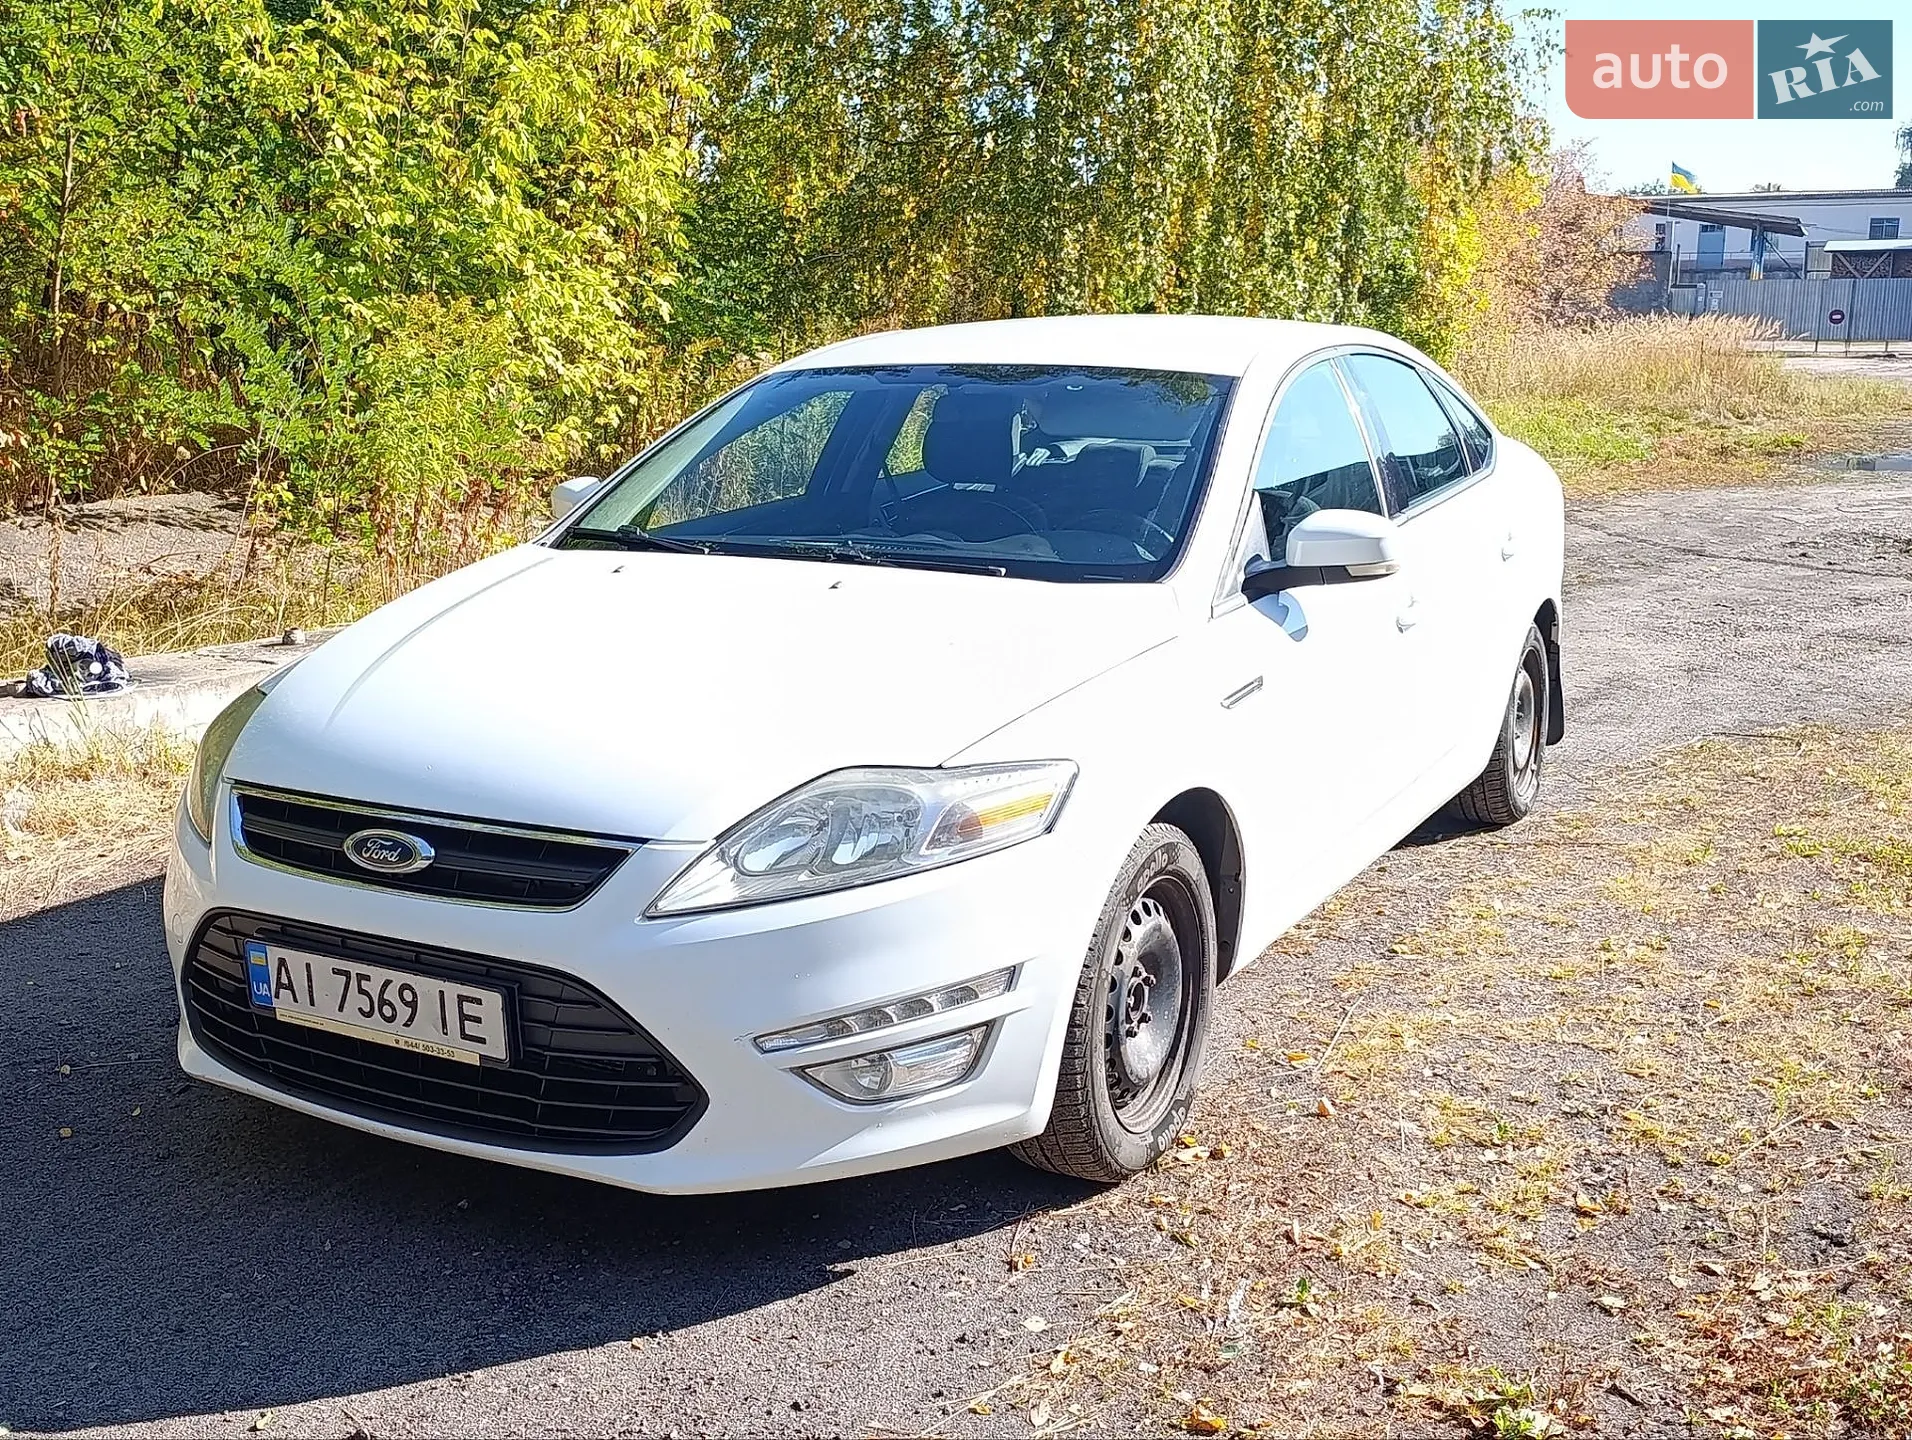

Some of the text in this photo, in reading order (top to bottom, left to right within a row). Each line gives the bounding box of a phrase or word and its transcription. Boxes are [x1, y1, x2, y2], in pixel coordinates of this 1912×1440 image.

[361, 838, 402, 862] Ford
[1137, 849, 1169, 893] apollo
[253, 981, 271, 997] UA
[274, 957, 486, 1045] AI 7569 IE
[1157, 1106, 1187, 1152] apollo
